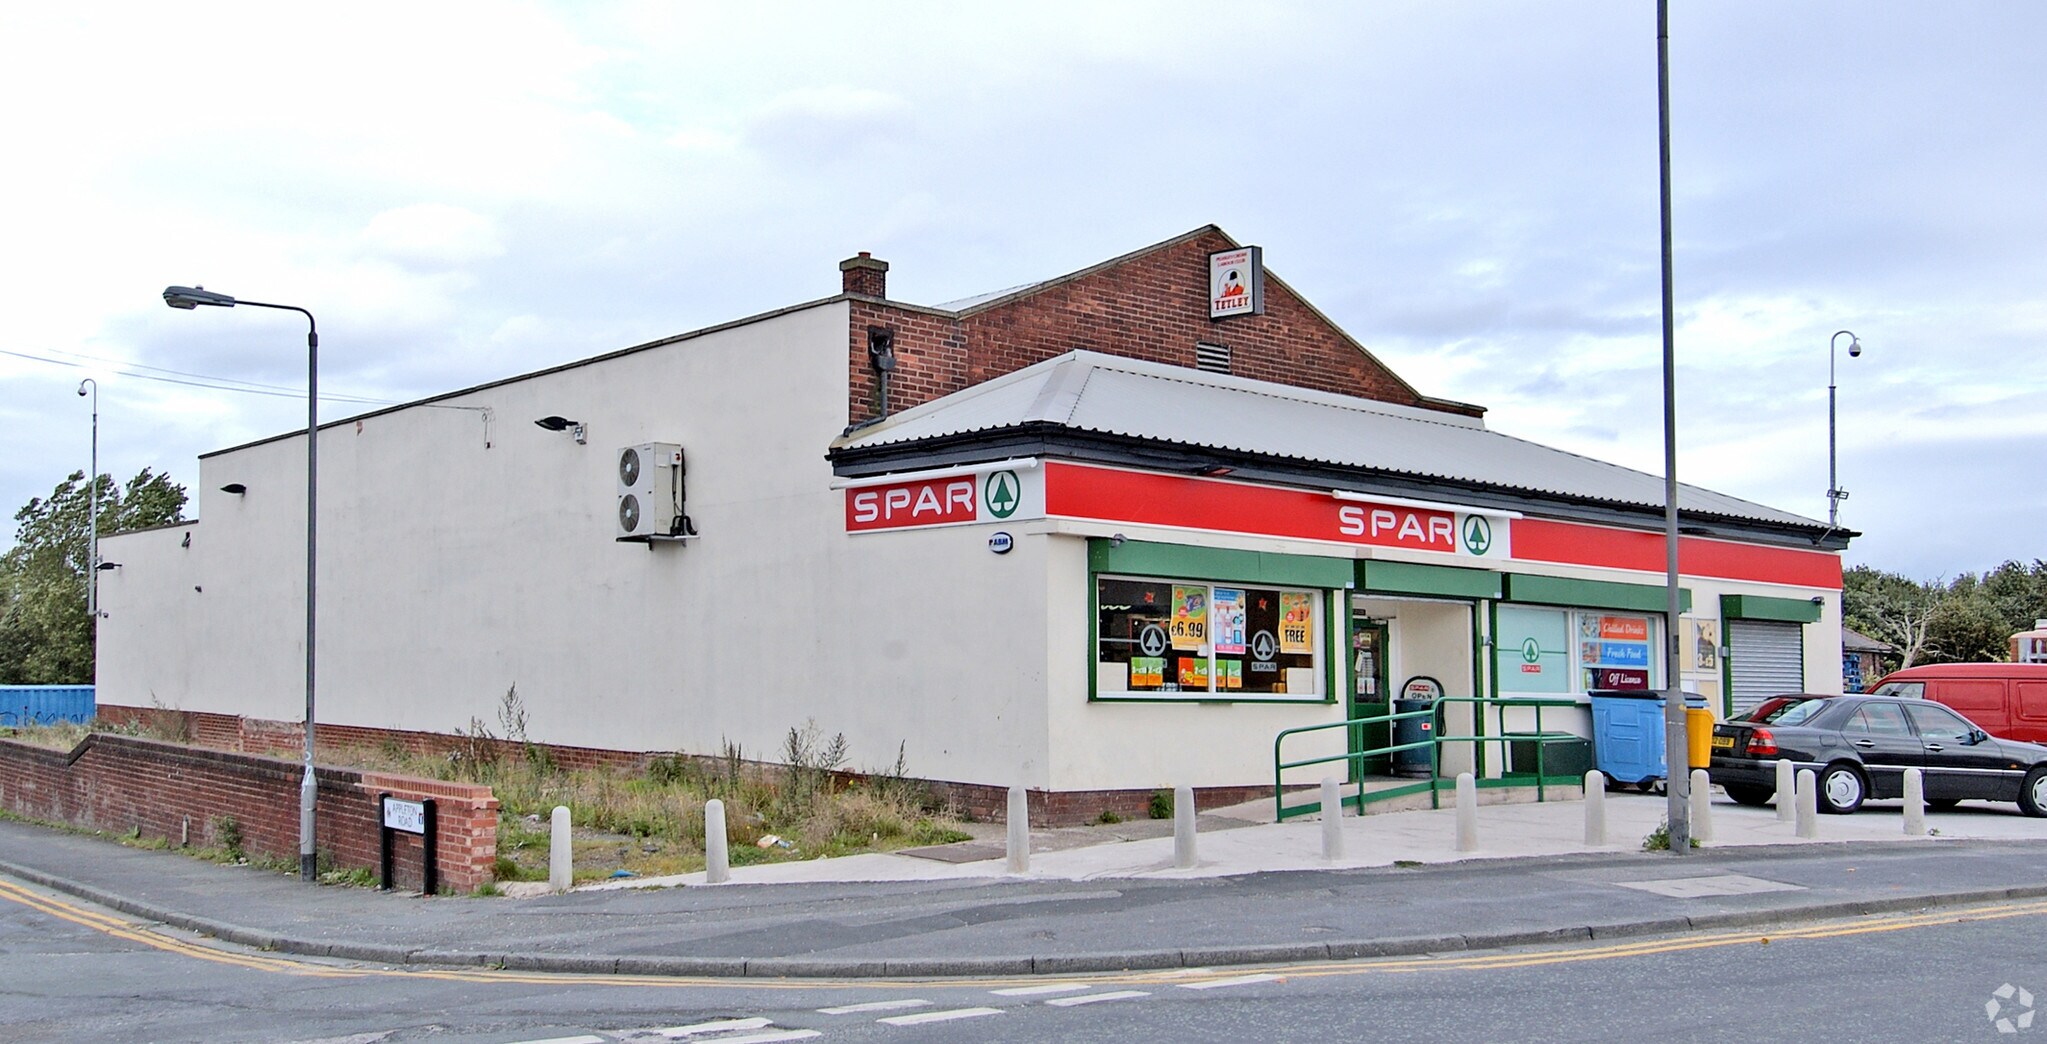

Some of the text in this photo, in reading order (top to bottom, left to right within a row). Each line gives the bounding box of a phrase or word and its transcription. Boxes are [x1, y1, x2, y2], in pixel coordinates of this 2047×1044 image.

[1215, 297, 1249, 310] TETLEY
[854, 482, 973, 522] SPAR
[1339, 506, 1453, 545] SPAR
[1171, 621, 1203, 638] £6.99
[1285, 629, 1305, 643] FREE
[1521, 665, 1541, 673] SPAR
[1609, 673, 1620, 686] Off
[393, 804, 417, 816] APPLETON
